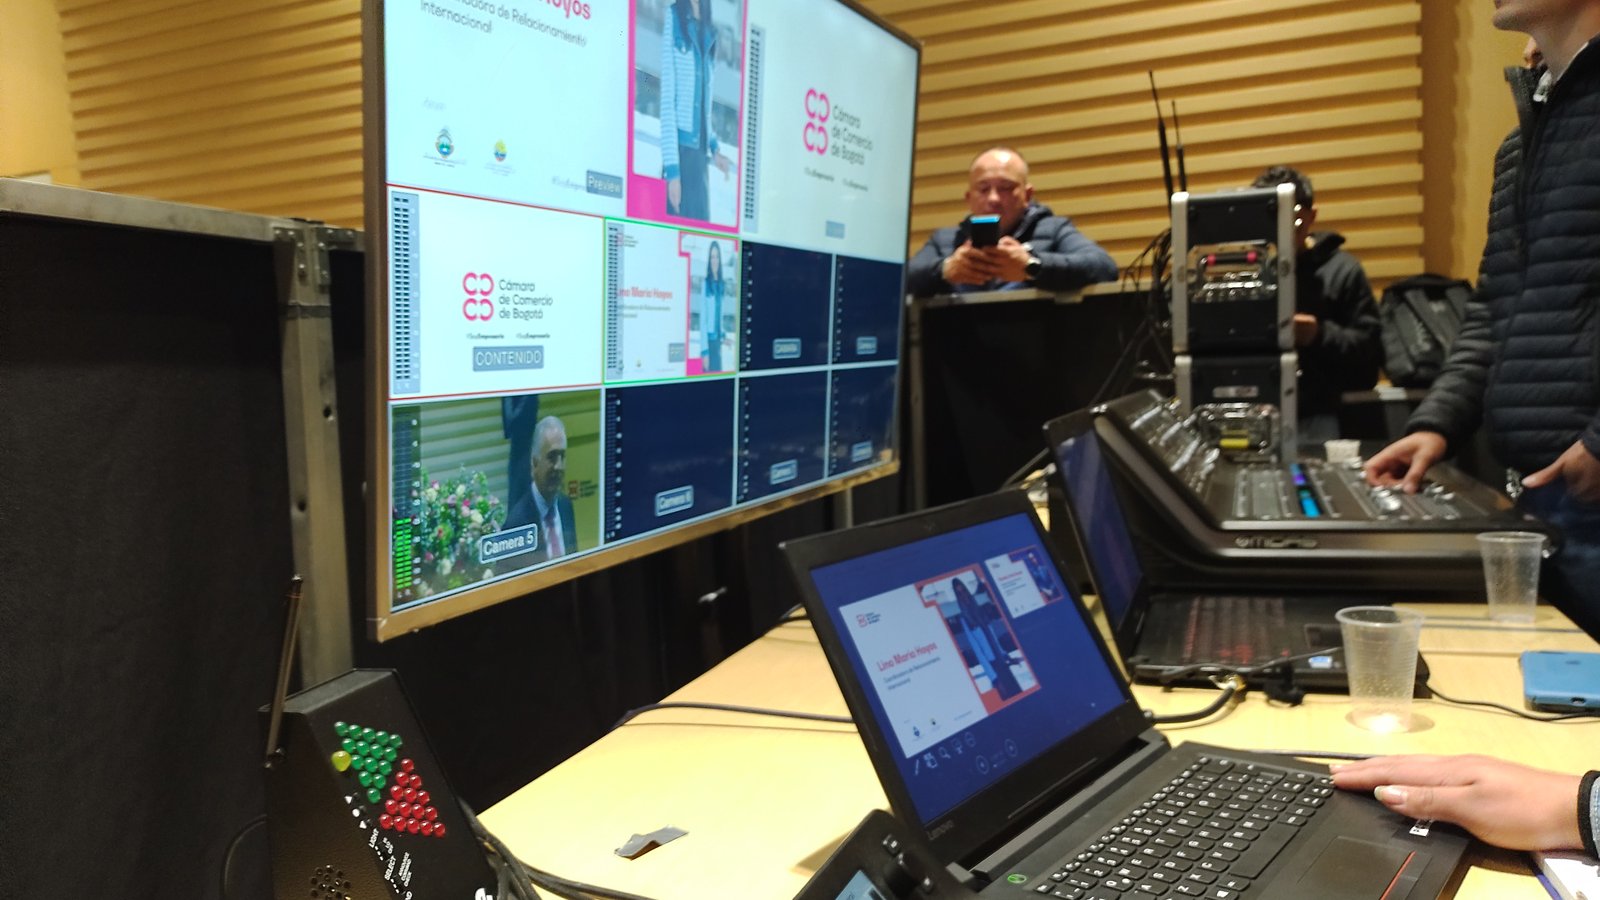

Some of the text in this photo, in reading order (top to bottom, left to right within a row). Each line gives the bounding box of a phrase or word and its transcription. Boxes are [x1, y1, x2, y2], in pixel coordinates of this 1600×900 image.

[420, 0, 493, 33] Internacional
[546, 0, 592, 19] oyos
[498, 4, 510, 20] de
[512, 8, 587, 47] Relacionamiento
[588, 174, 622, 194] Preview
[498, 279, 536, 292] Cámara
[498, 293, 554, 306] de Comercio
[498, 307, 544, 321] de Bogotá
[475, 350, 541, 367] CONTENIDO
[483, 530, 534, 556] Camera 5
[368, 828, 380, 848] LIGHT
[384, 856, 396, 880] SELECT
